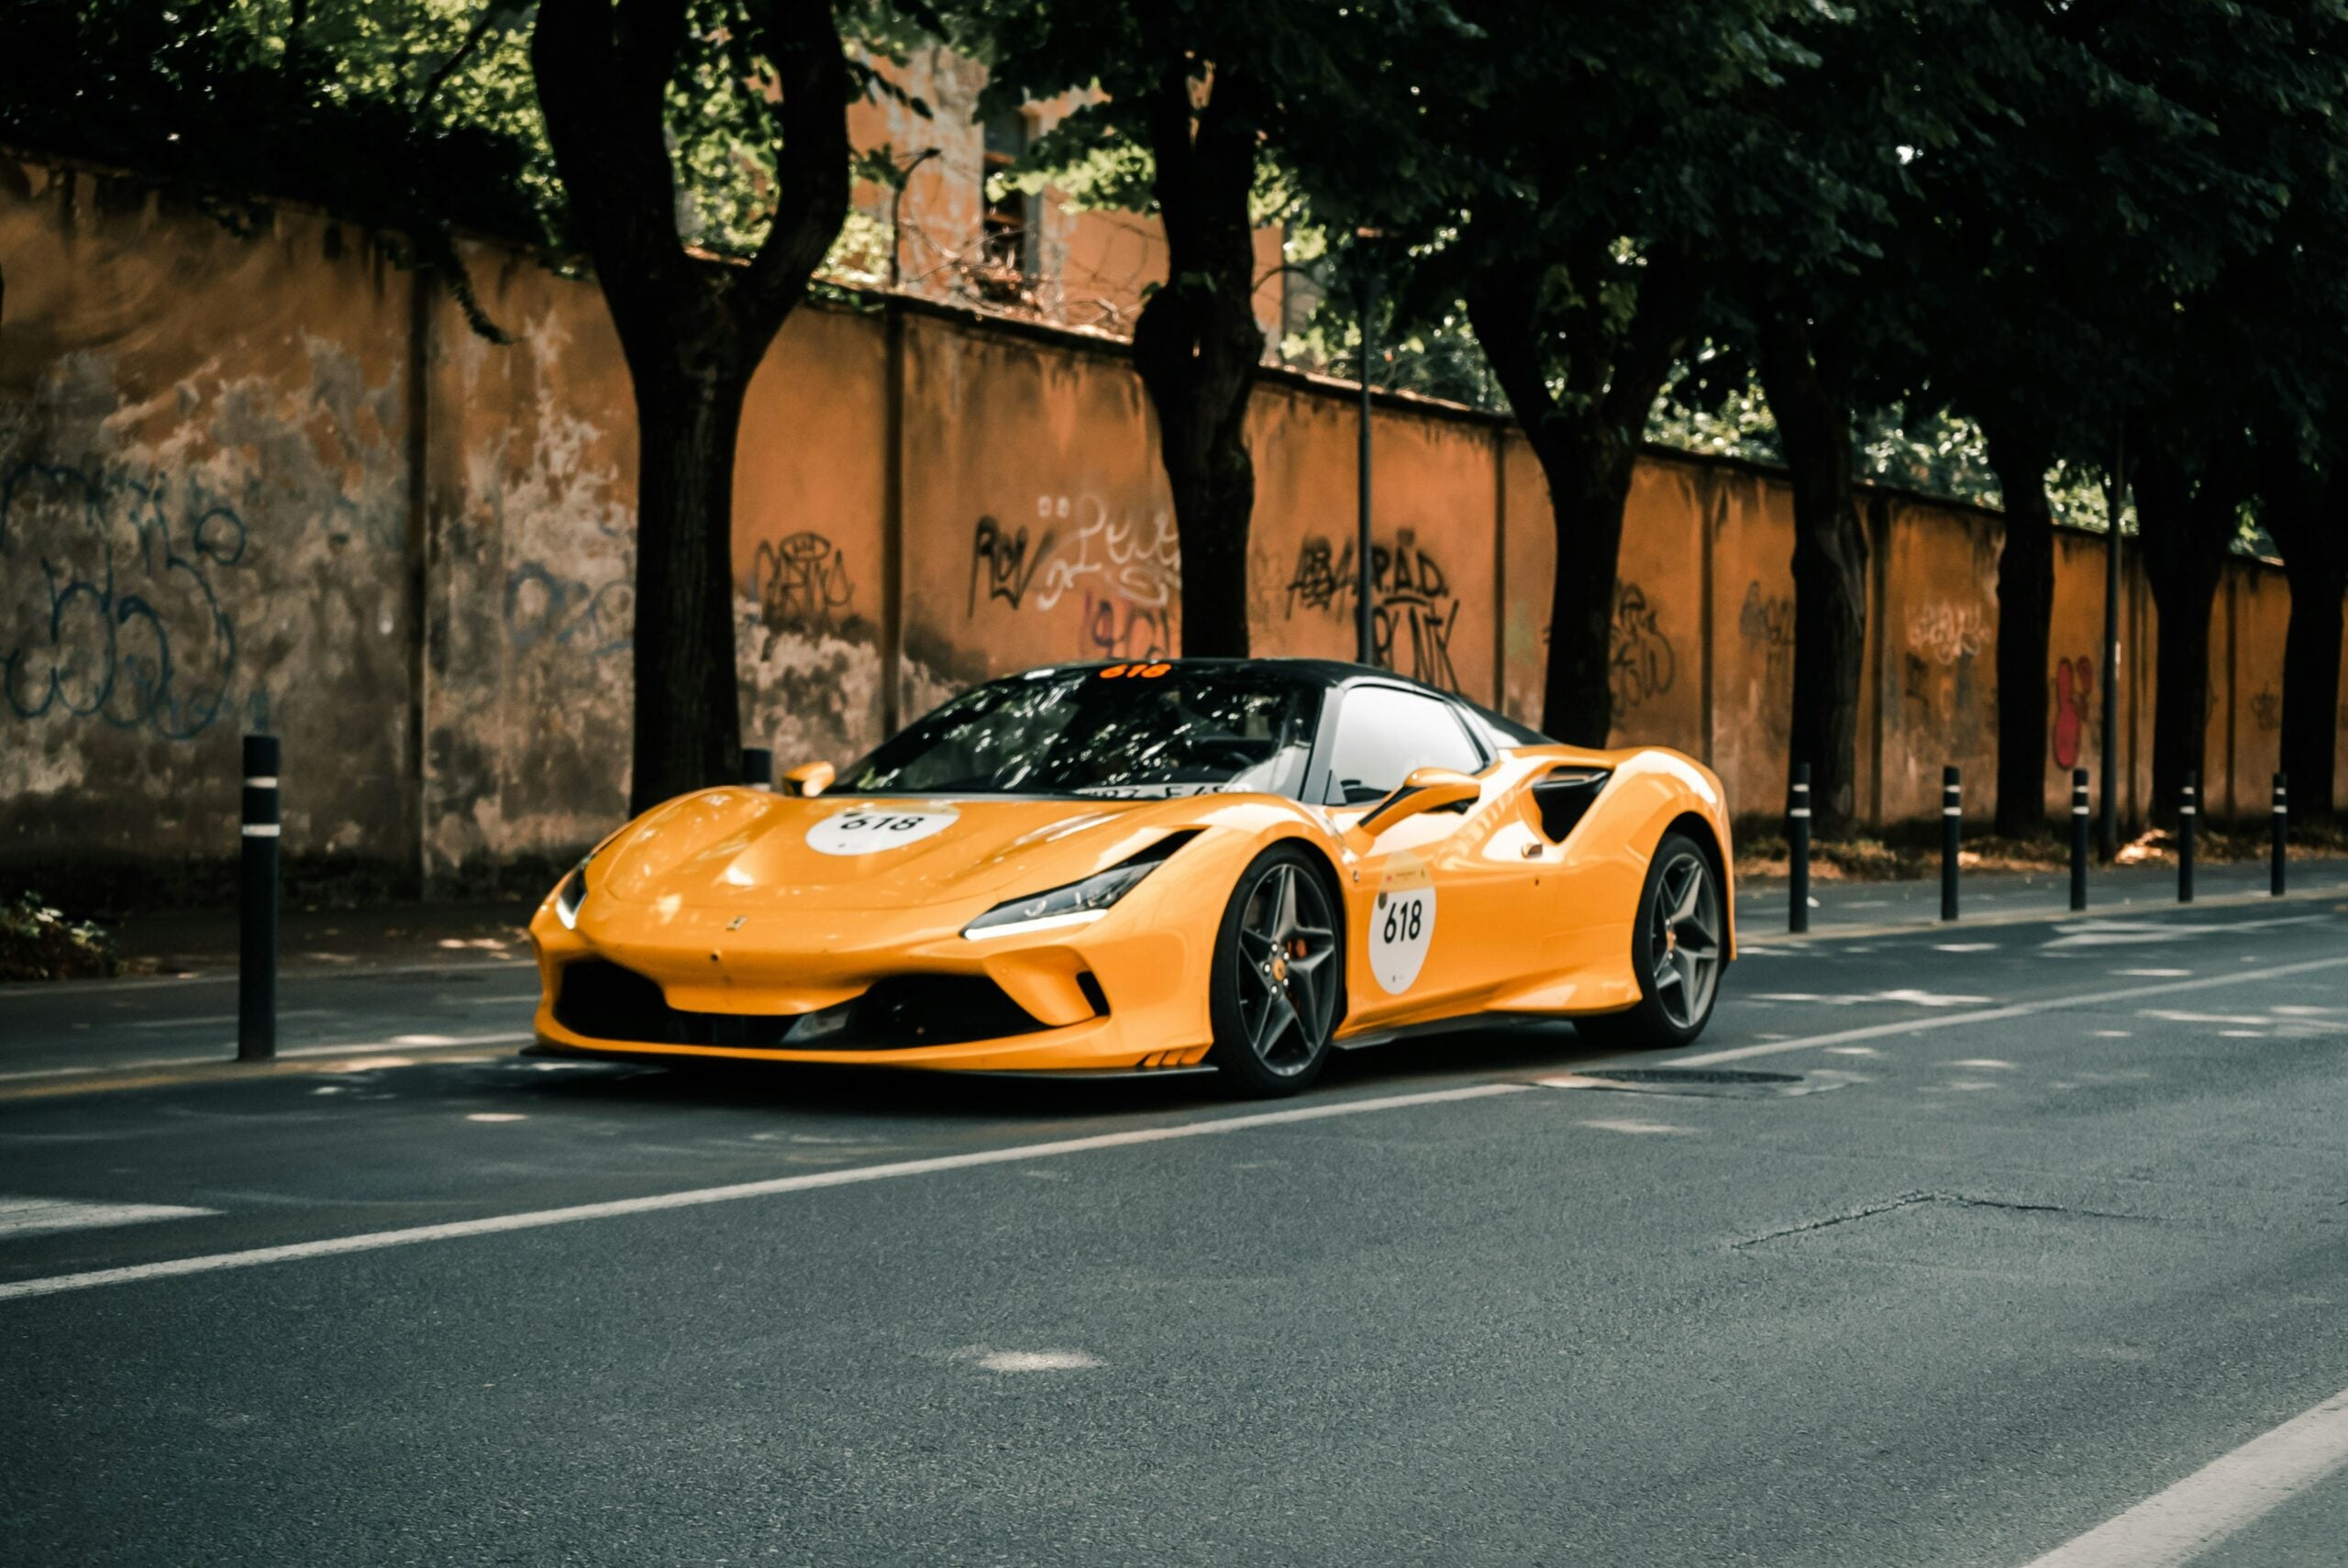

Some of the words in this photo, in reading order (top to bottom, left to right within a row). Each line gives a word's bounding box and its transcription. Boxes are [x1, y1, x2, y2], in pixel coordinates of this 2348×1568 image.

[1100, 663, 1172, 679] 618
[840, 815, 925, 831] 618
[1383, 899, 1423, 944] 618
